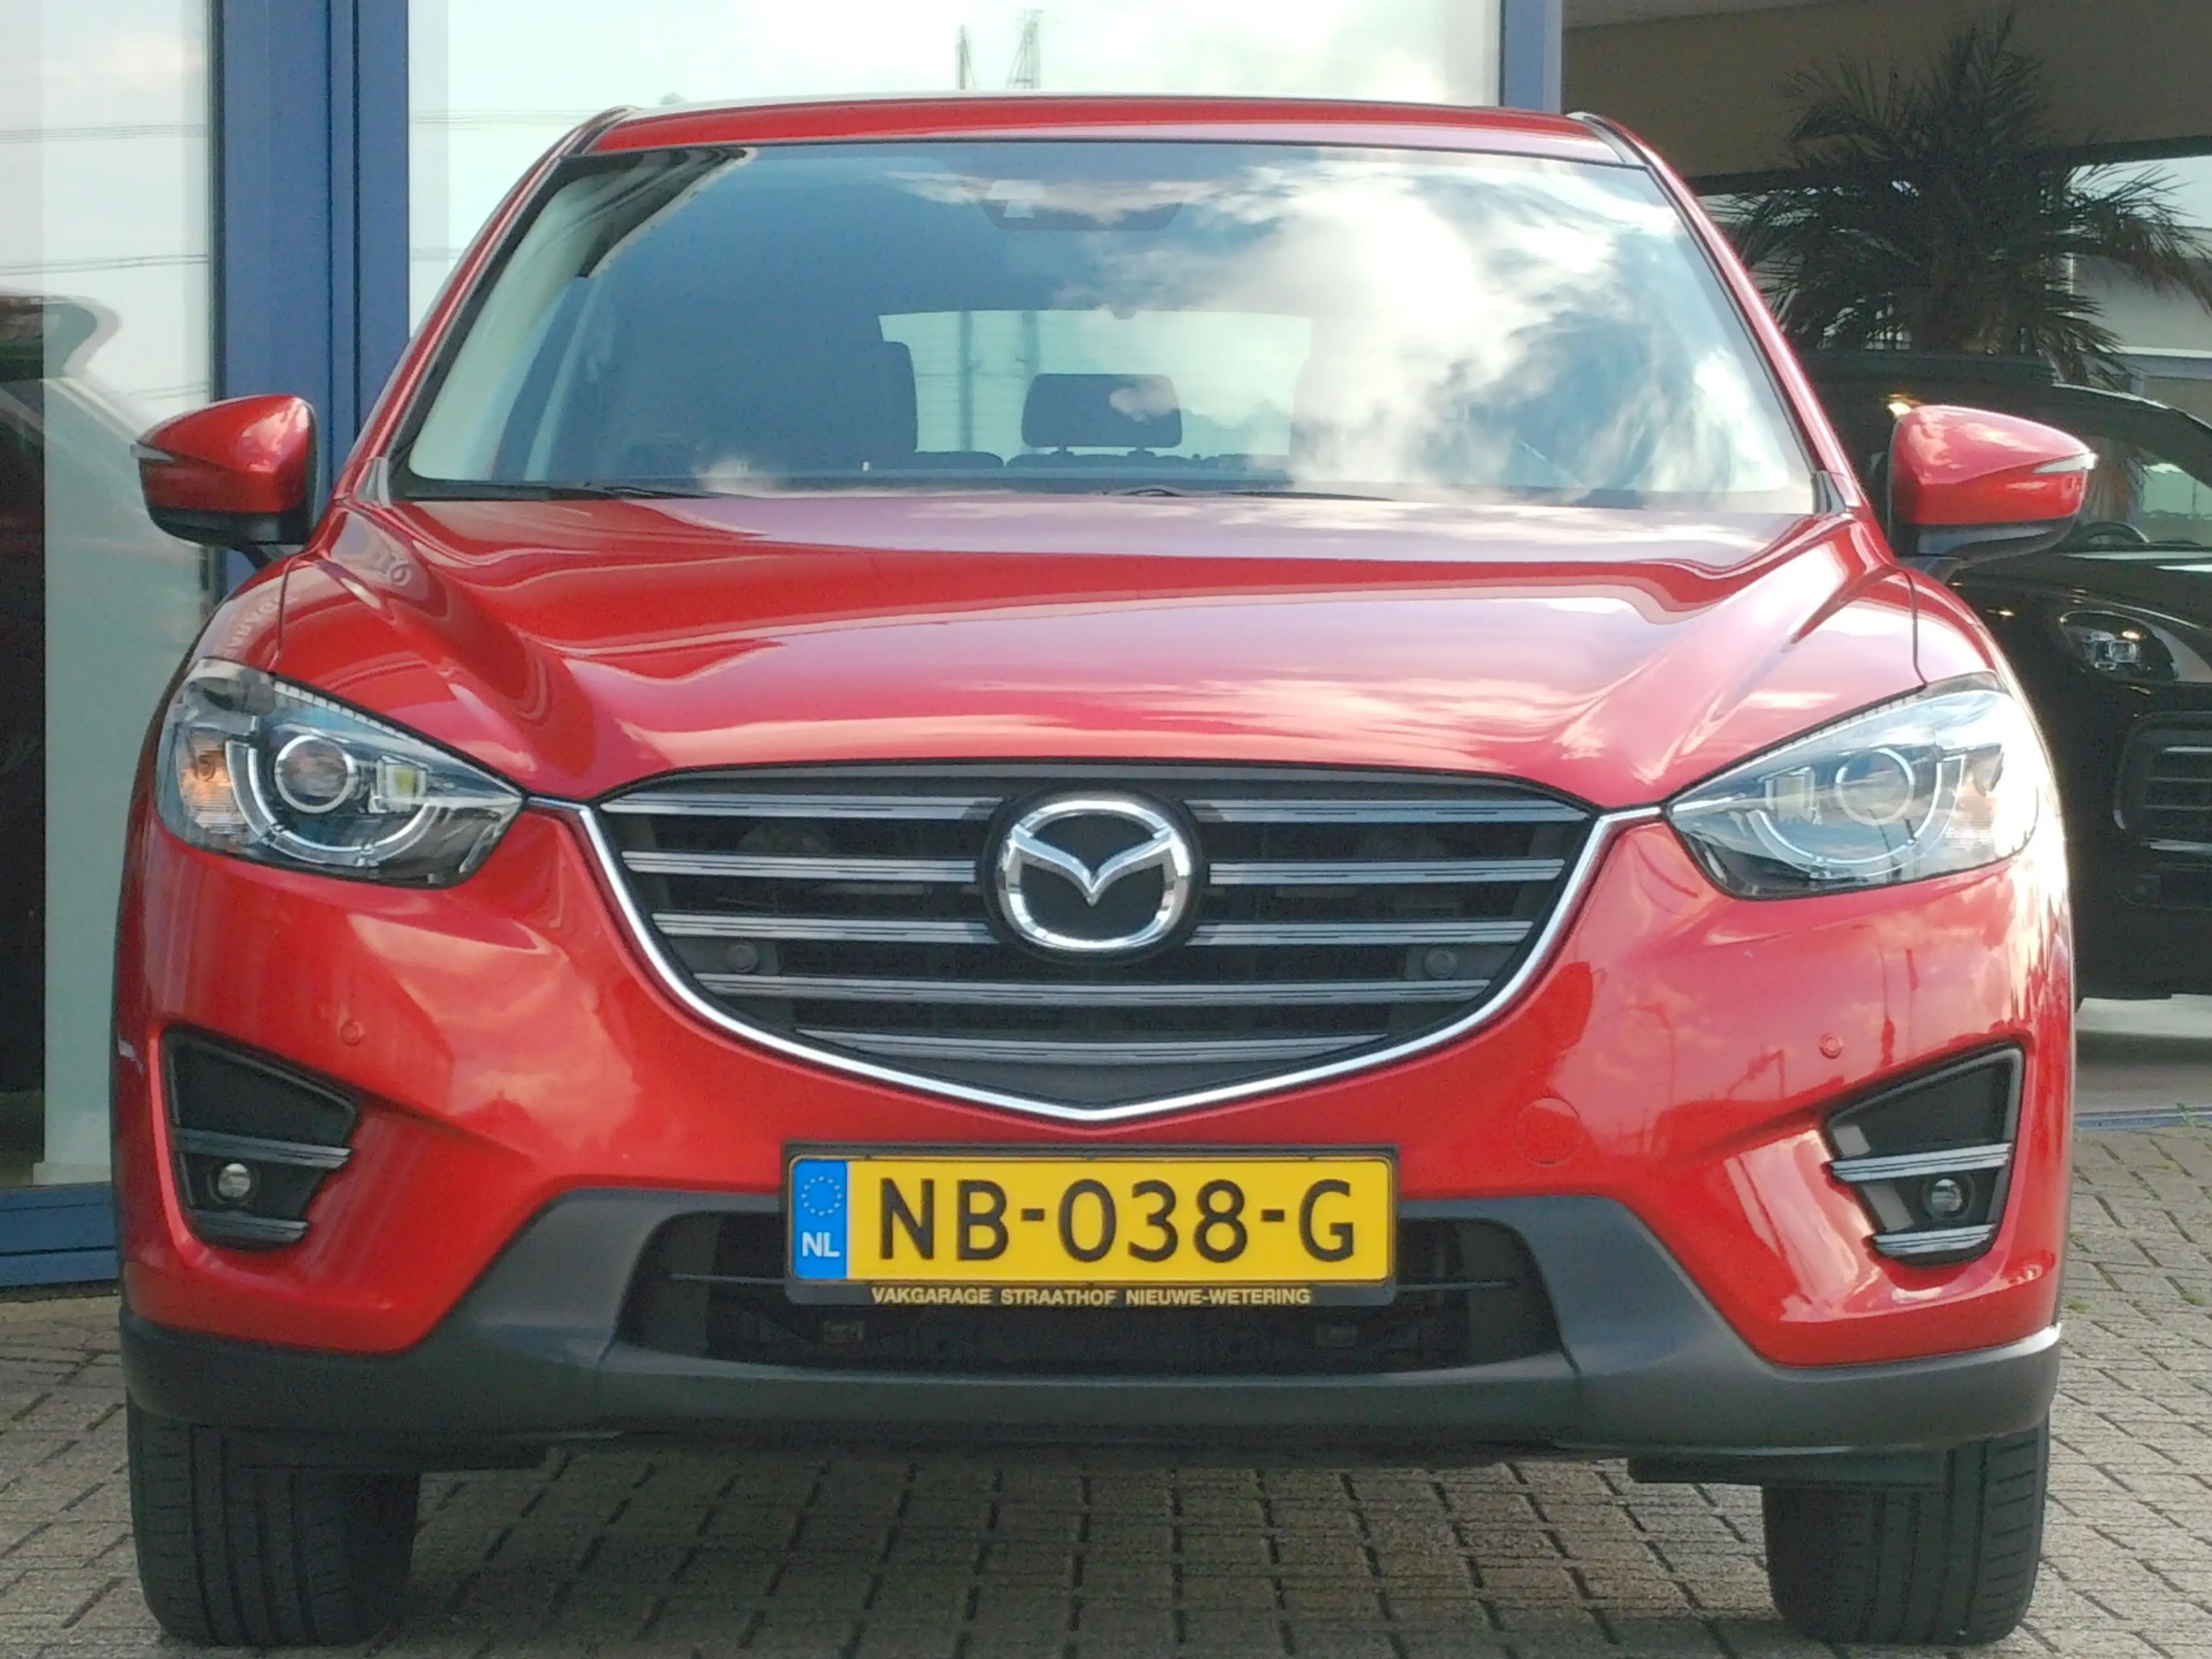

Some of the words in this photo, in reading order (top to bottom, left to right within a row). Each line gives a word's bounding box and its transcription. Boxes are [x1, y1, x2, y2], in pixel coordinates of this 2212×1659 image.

[879, 1177, 1354, 1264] NB-038-G
[802, 1232, 840, 1257] NL
[871, 1287, 992, 1305] VAKGARAGE
[1001, 1287, 1118, 1305] STRAATHOF
[1126, 1287, 1311, 1305] NIEUWE-WETERING
